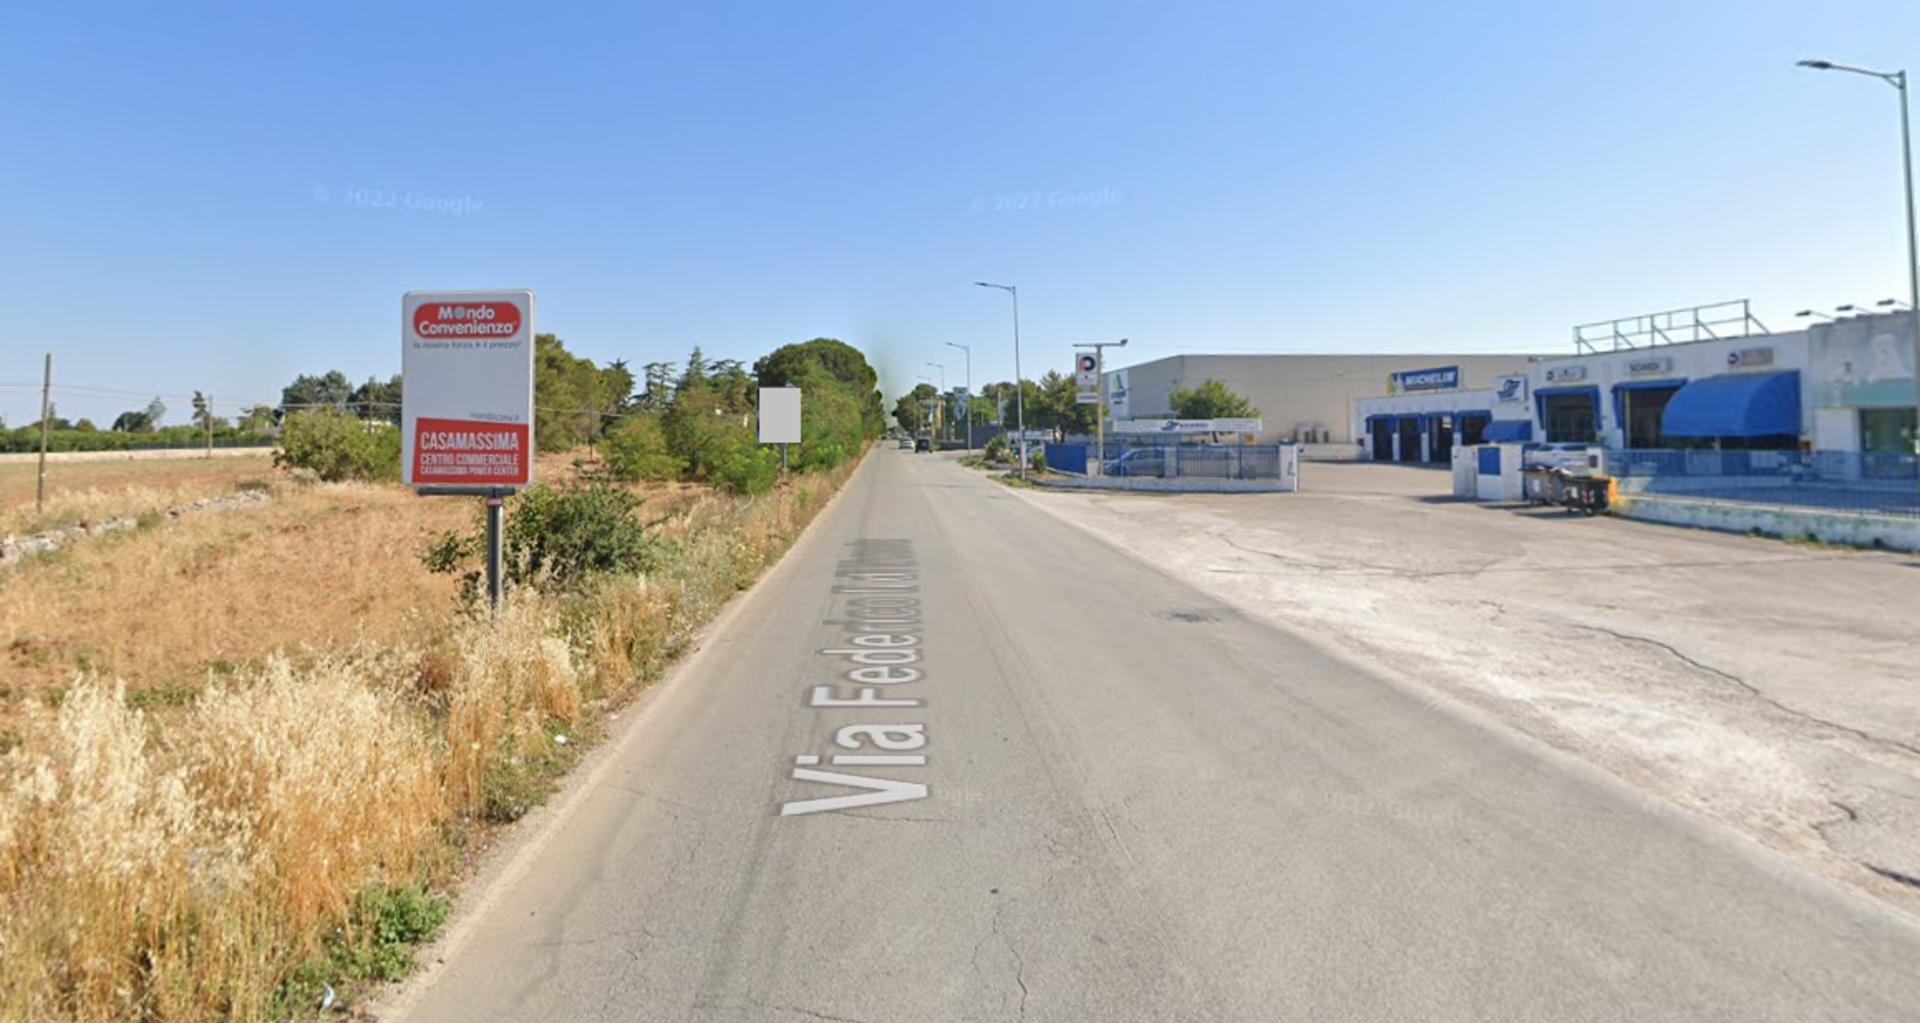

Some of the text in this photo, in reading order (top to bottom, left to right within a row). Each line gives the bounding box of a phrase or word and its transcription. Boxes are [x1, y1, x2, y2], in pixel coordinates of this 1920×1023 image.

[438, 305, 496, 320] Mondo
[419, 320, 514, 336] Convenienza
[1405, 371, 1457, 386] MICHELIN
[421, 432, 519, 450] CASAMASSIMA
[420, 453, 519, 465] CENTRO COMMERCIALE
